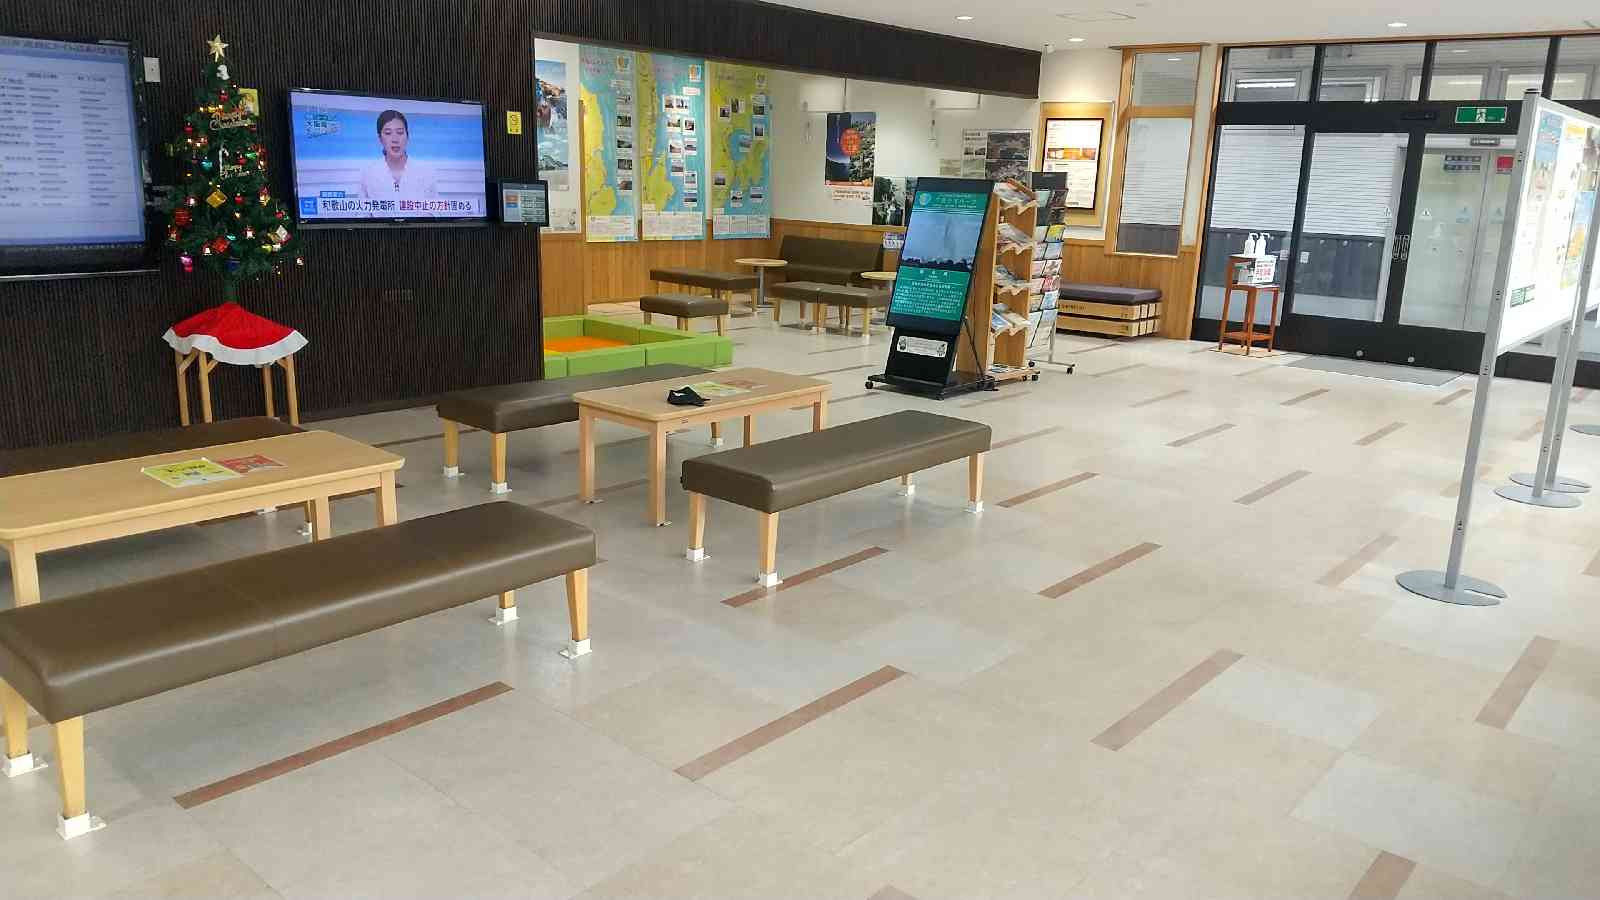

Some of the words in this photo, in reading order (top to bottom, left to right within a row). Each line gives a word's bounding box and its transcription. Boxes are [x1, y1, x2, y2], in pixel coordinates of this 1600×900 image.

[322, 199, 395, 211] 和歌山の火力発電所
[399, 199, 472, 211] 建設中止の方針固める
